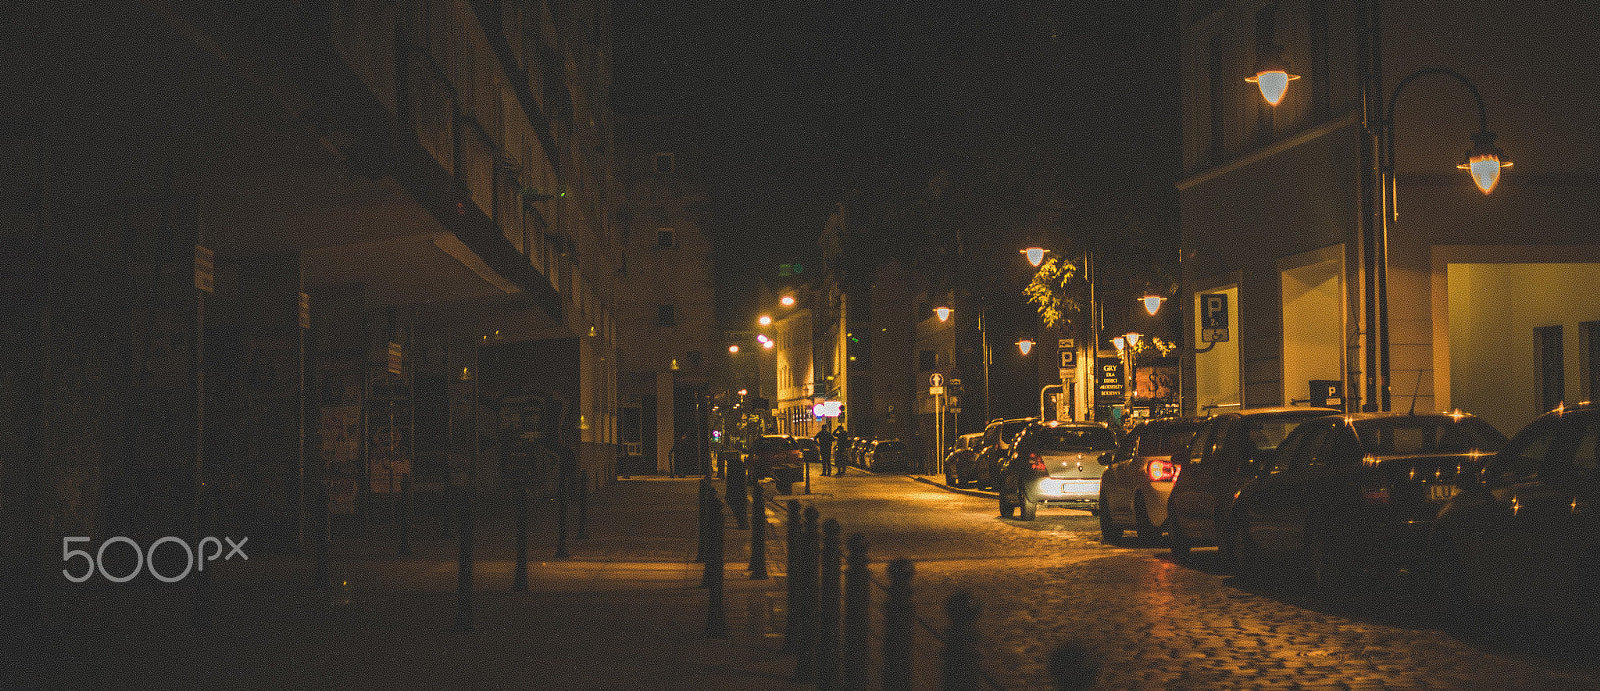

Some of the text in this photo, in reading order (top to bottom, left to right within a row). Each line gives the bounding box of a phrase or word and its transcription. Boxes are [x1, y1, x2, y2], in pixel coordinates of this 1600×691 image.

[1208, 297, 1222, 318] P
[1061, 351, 1073, 367] P
[1328, 386, 1336, 397] P
